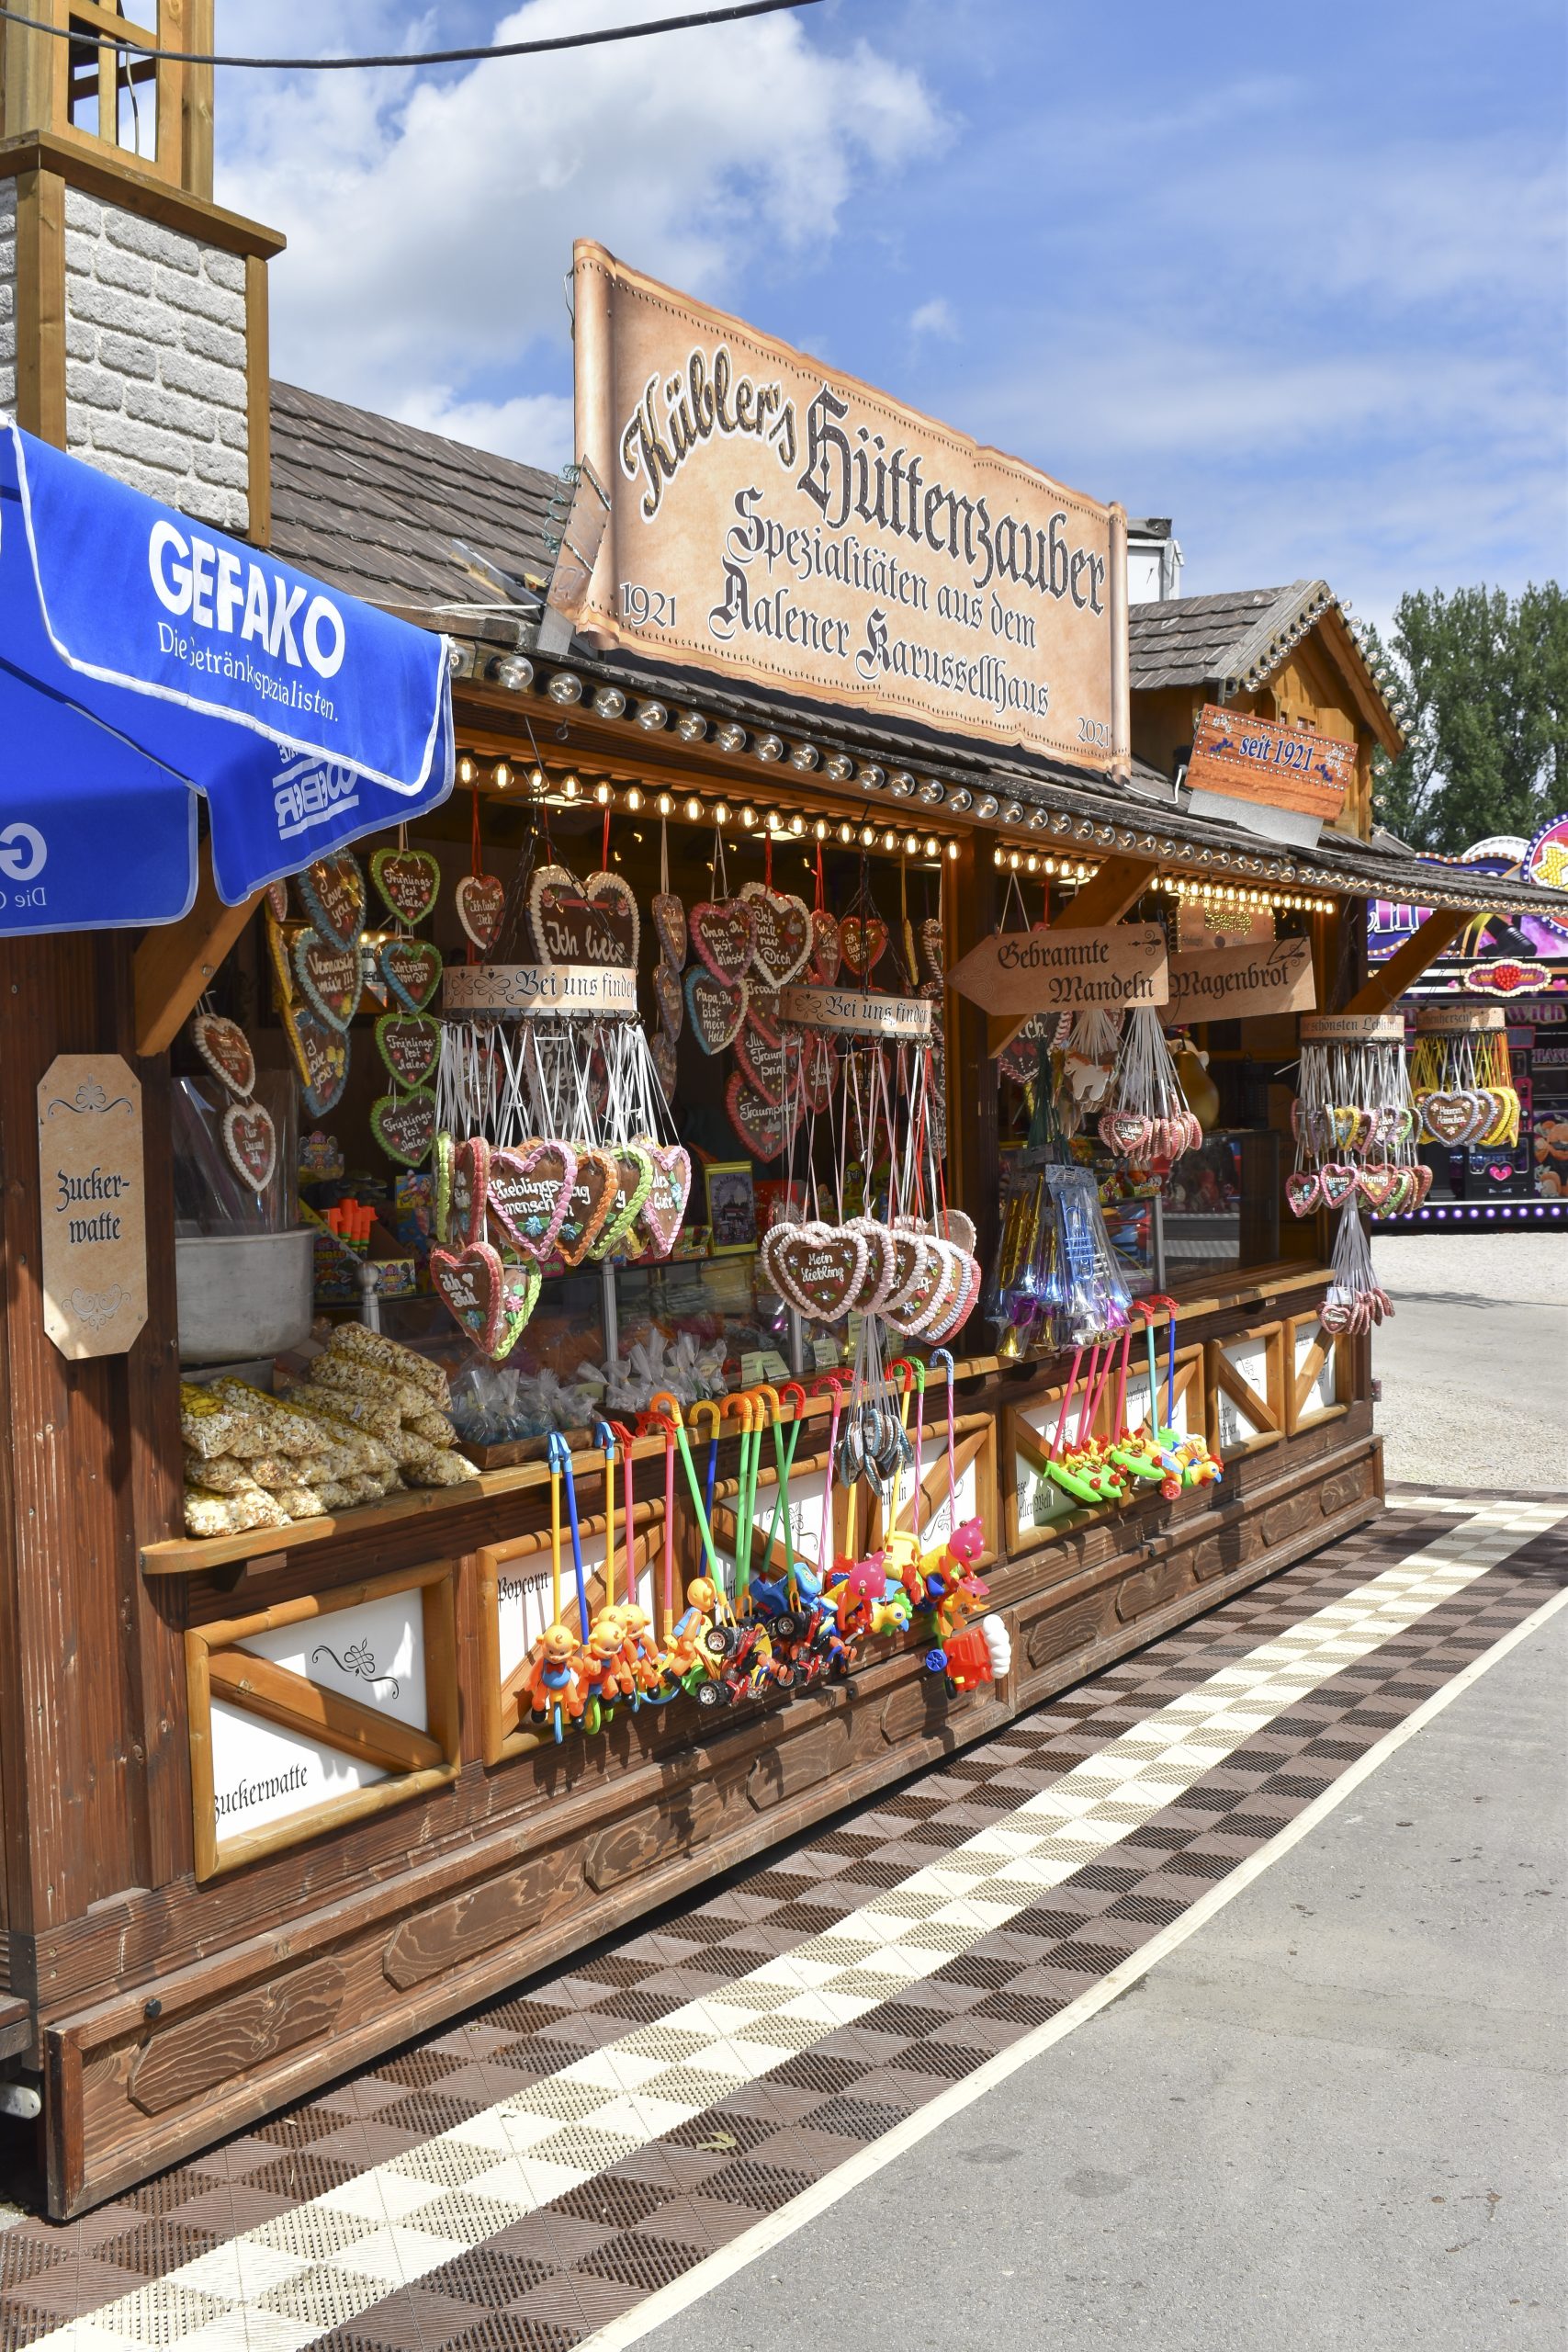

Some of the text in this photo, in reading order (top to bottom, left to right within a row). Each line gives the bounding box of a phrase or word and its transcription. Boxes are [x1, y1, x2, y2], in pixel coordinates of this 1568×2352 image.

[797, 381, 1106, 616] Hüttenzauber
[727, 486, 1038, 650] Spezialitäten aus dem
[149, 520, 346, 678] GEFAKO
[621, 582, 677, 628] 1921
[160, 622, 187, 660] Die
[708, 556, 1051, 718] Aalener Karussellhaus
[1077, 717, 1111, 749] 2021
[1239, 733, 1314, 773] seit 1921
[321, 886, 344, 909] love
[332, 901, 351, 928] you
[729, 920, 745, 933] Du
[753, 904, 774, 924] Ich
[546, 921, 580, 956] Ich
[758, 923, 777, 937] will
[761, 936, 780, 946] nur
[712, 937, 734, 952] bist
[761, 946, 792, 966] Dich
[997, 940, 1110, 970] Gebrannte
[515, 968, 556, 997] Bei
[563, 976, 598, 996] uns
[1049, 970, 1155, 1004] Mandeln
[1168, 961, 1291, 1000] Magenbrot
[702, 1003, 722, 1017] bist
[826, 996, 856, 1018] Bei
[863, 1006, 892, 1021] uns
[703, 1017, 726, 1030] mein
[387, 1035, 434, 1052] Frühlings-
[707, 1031, 724, 1043] Held
[404, 1047, 421, 1060] fest
[313, 1065, 333, 1094] you
[383, 1110, 434, 1132] Frühlings-
[402, 1126, 421, 1139] fest
[56, 1167, 130, 1213] Zucker-
[490, 1176, 563, 1201] Lieblings-
[1361, 1172, 1389, 1186] Honey
[504, 1194, 555, 1216] mensch
[69, 1211, 121, 1244] watte
[808, 1253, 833, 1266] Mein
[801, 1264, 844, 1283] Liebling
[497, 1570, 548, 1605] Popcorn
